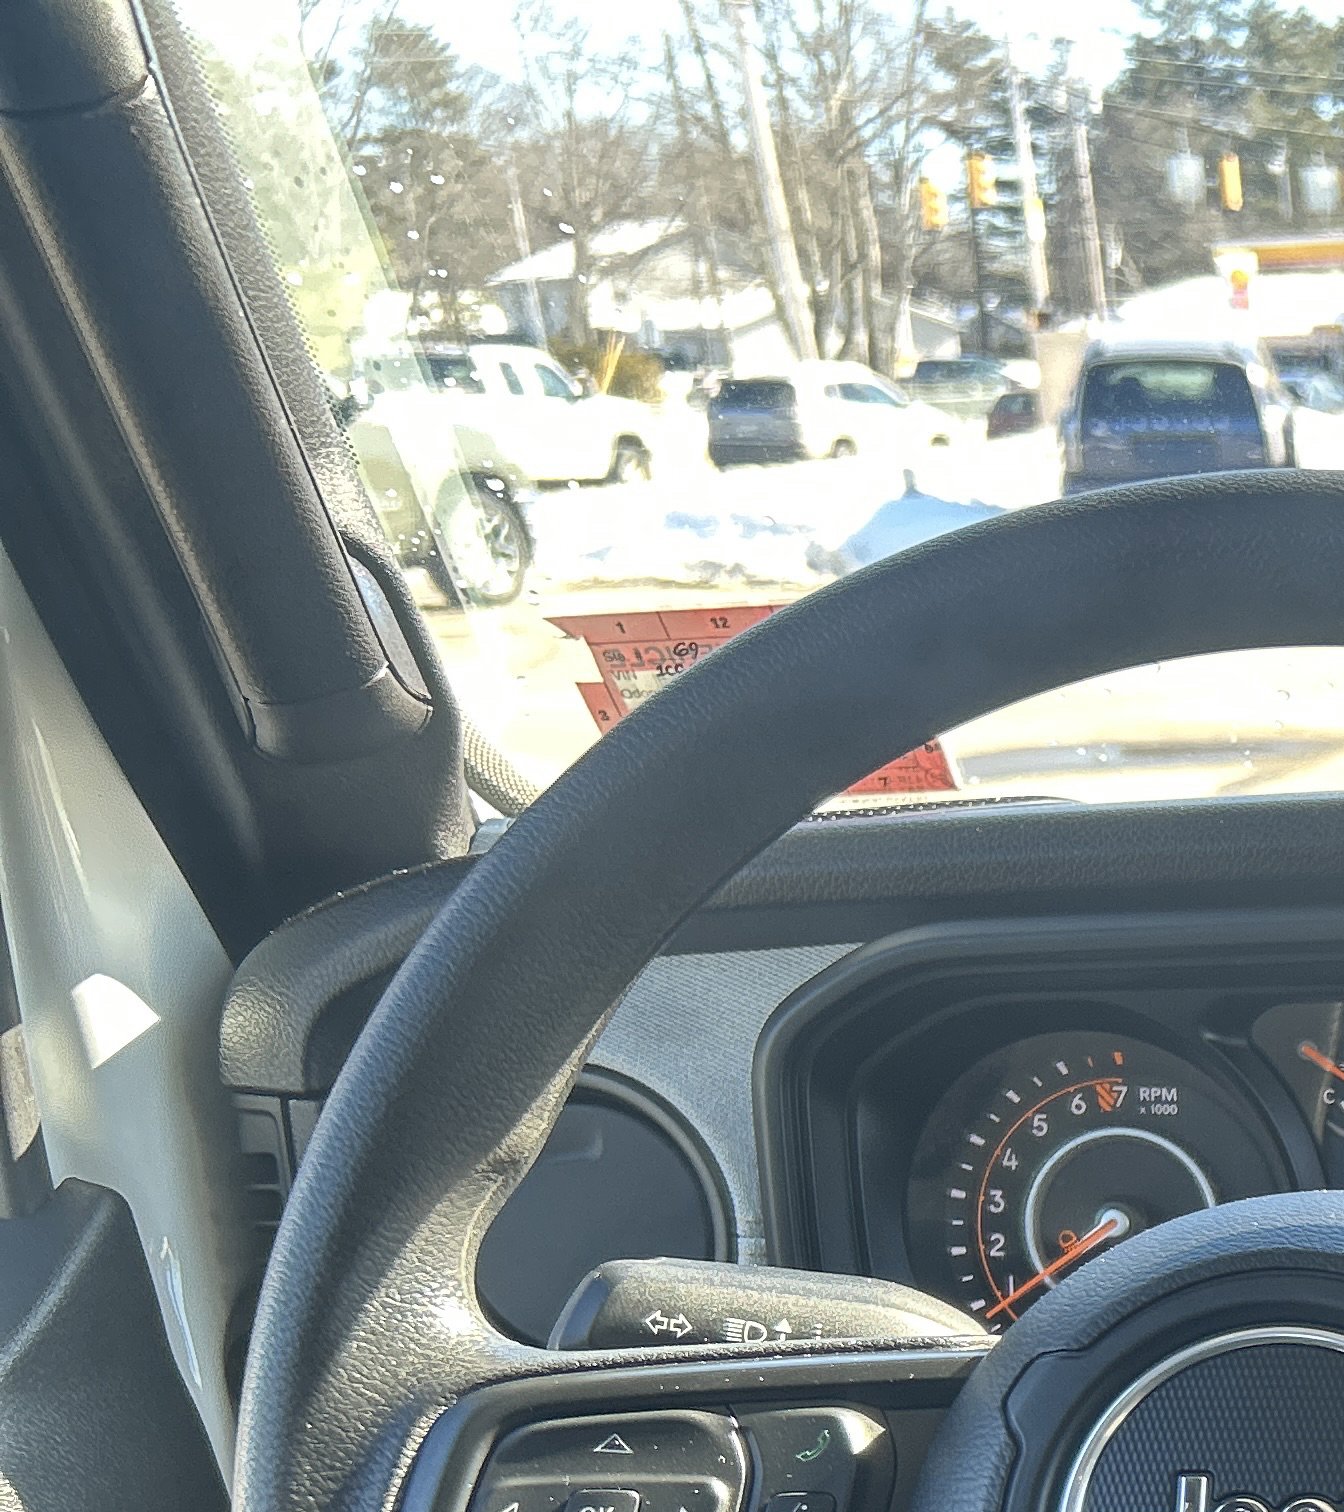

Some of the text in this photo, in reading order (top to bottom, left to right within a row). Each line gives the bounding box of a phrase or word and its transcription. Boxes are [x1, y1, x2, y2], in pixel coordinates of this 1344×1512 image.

[710, 616, 731, 629] 12
[1070, 1093, 1087, 1115] 6
[1112, 1085, 1128, 1107] 7
[1139, 1086, 1178, 1102] RPM
[1322, 1087, 1336, 1105] C
[1150, 1104, 1178, 1115] 1000
[1031, 1113, 1049, 1137] 5
[1001, 1147, 1019, 1170] 4
[989, 1190, 1005, 1214] 3
[989, 1232, 1006, 1257] 2
